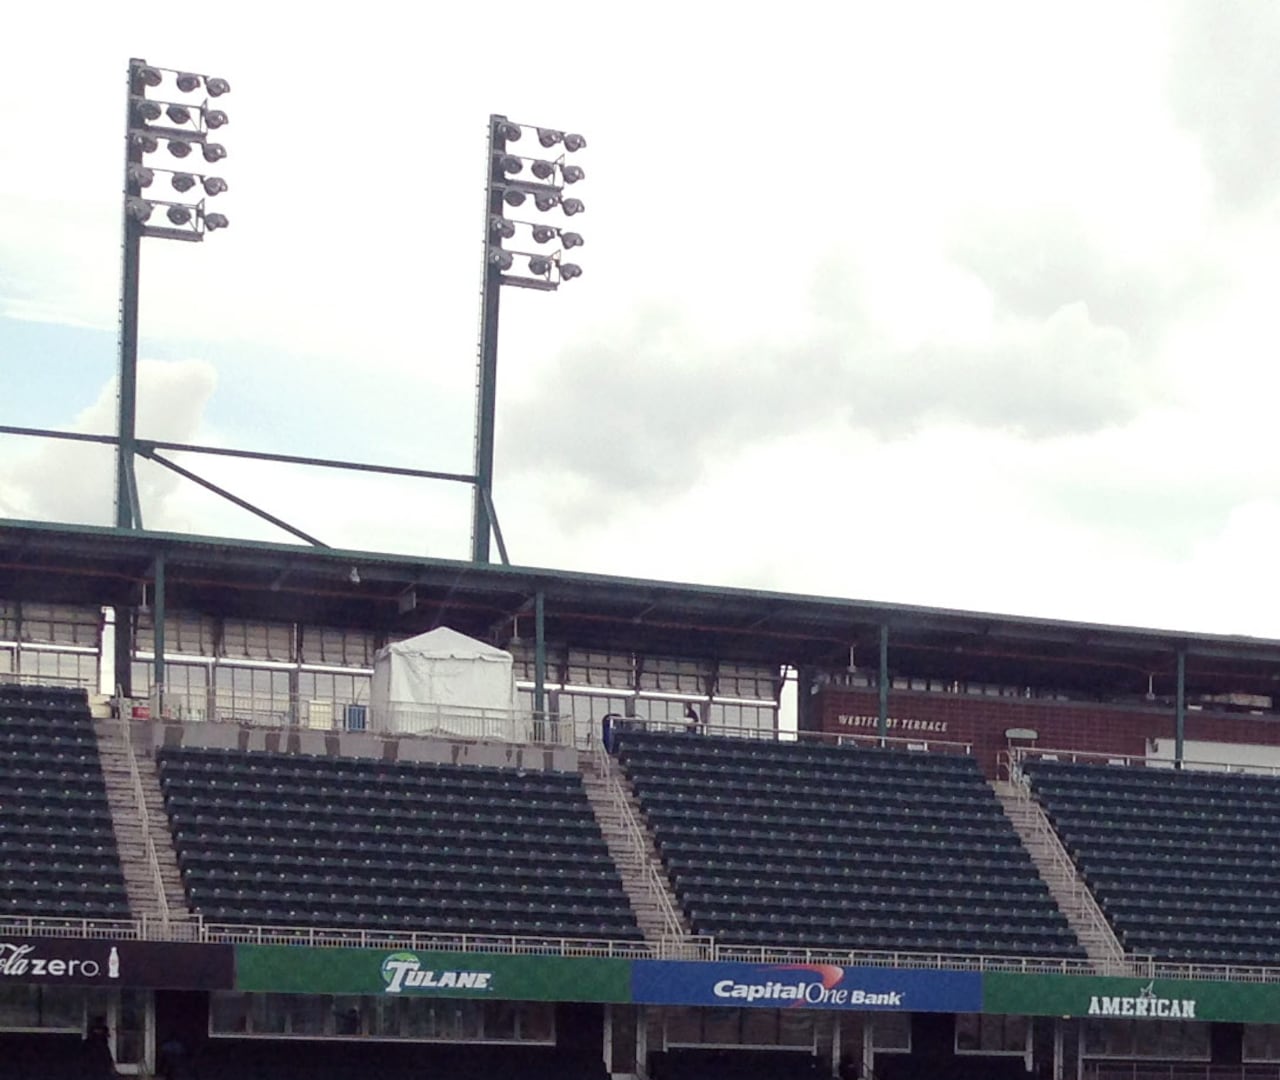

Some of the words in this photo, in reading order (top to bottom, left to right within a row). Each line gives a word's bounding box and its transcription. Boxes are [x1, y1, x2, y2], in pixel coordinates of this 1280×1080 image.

[838, 715, 898, 729] WESTFEDT
[901, 719, 948, 732] TERRACE
[31, 959, 99, 977] zero
[385, 961, 492, 993] TULANE
[851, 991, 901, 1005] Bank
[1088, 996, 1196, 1018] AMERICAN
